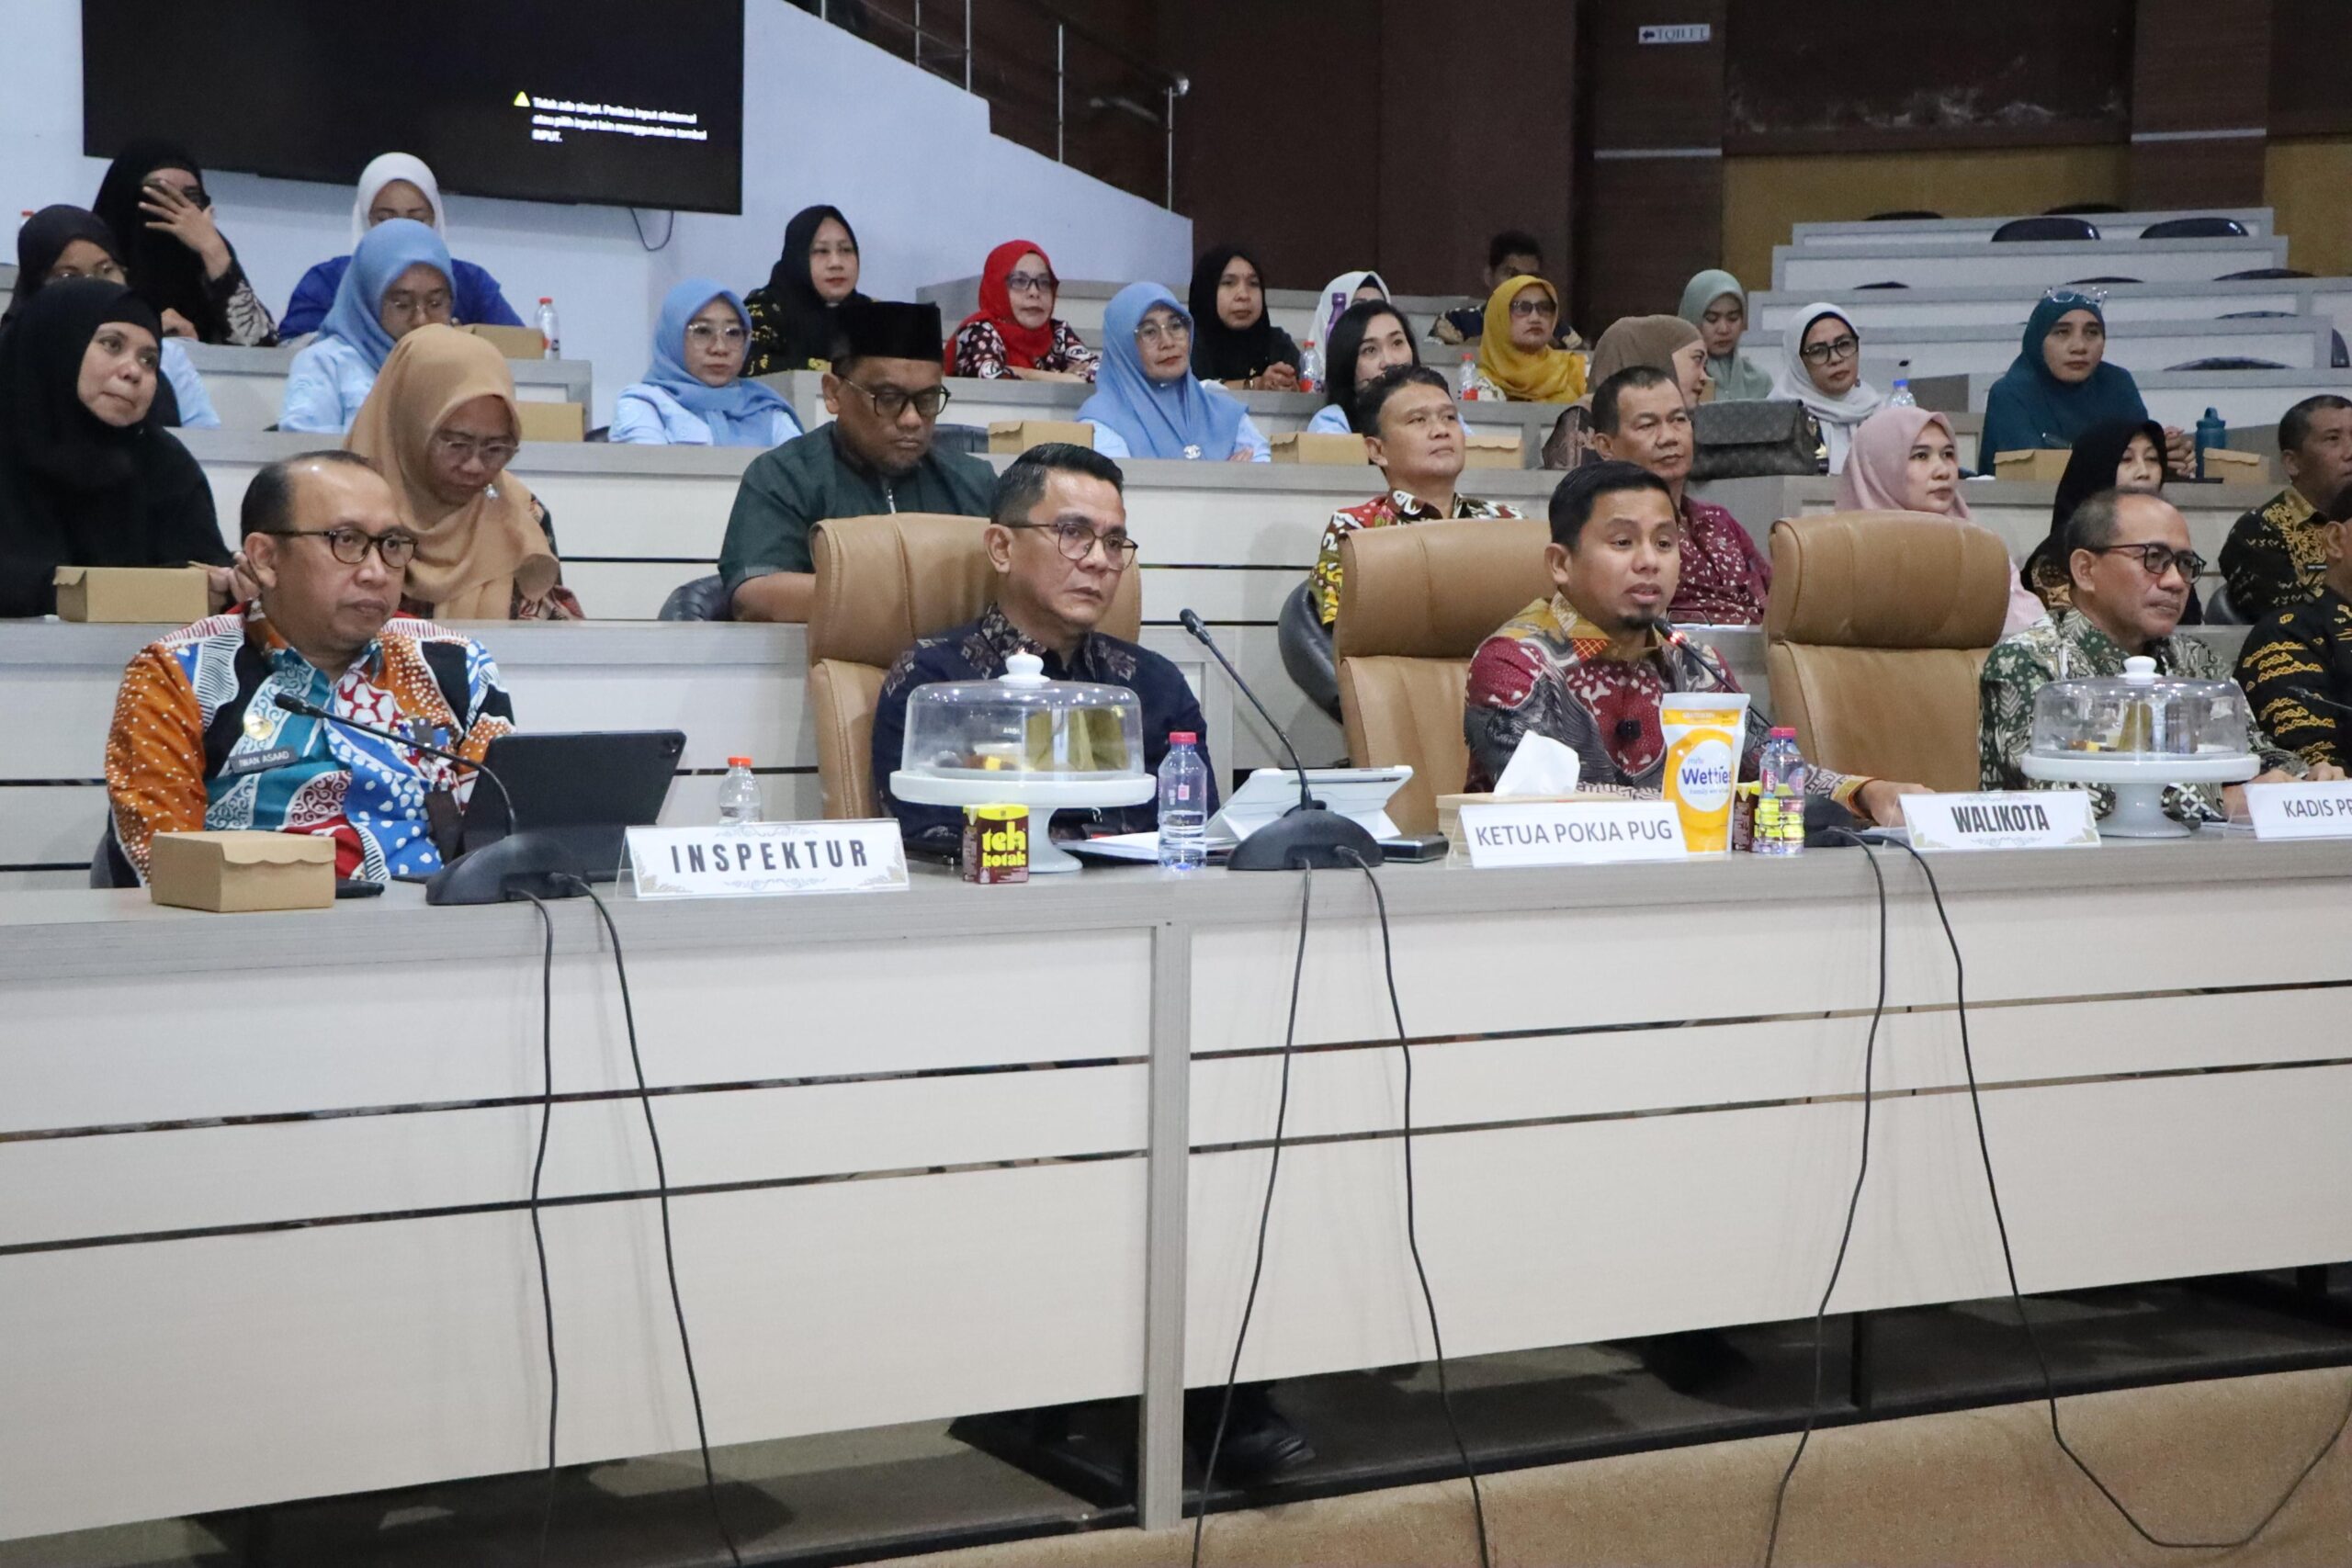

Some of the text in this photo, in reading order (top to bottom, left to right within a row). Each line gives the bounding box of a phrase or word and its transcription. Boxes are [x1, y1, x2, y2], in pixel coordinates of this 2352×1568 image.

[1951, 804, 2051, 833] WALIKOTA
[2283, 798, 2334, 818] KADIS
[981, 820, 1026, 852] teh
[1475, 820, 1673, 846] KETUA POKJA PUG
[671, 840, 868, 874] INSPEKTUR
[982, 851, 1026, 868] kotak
